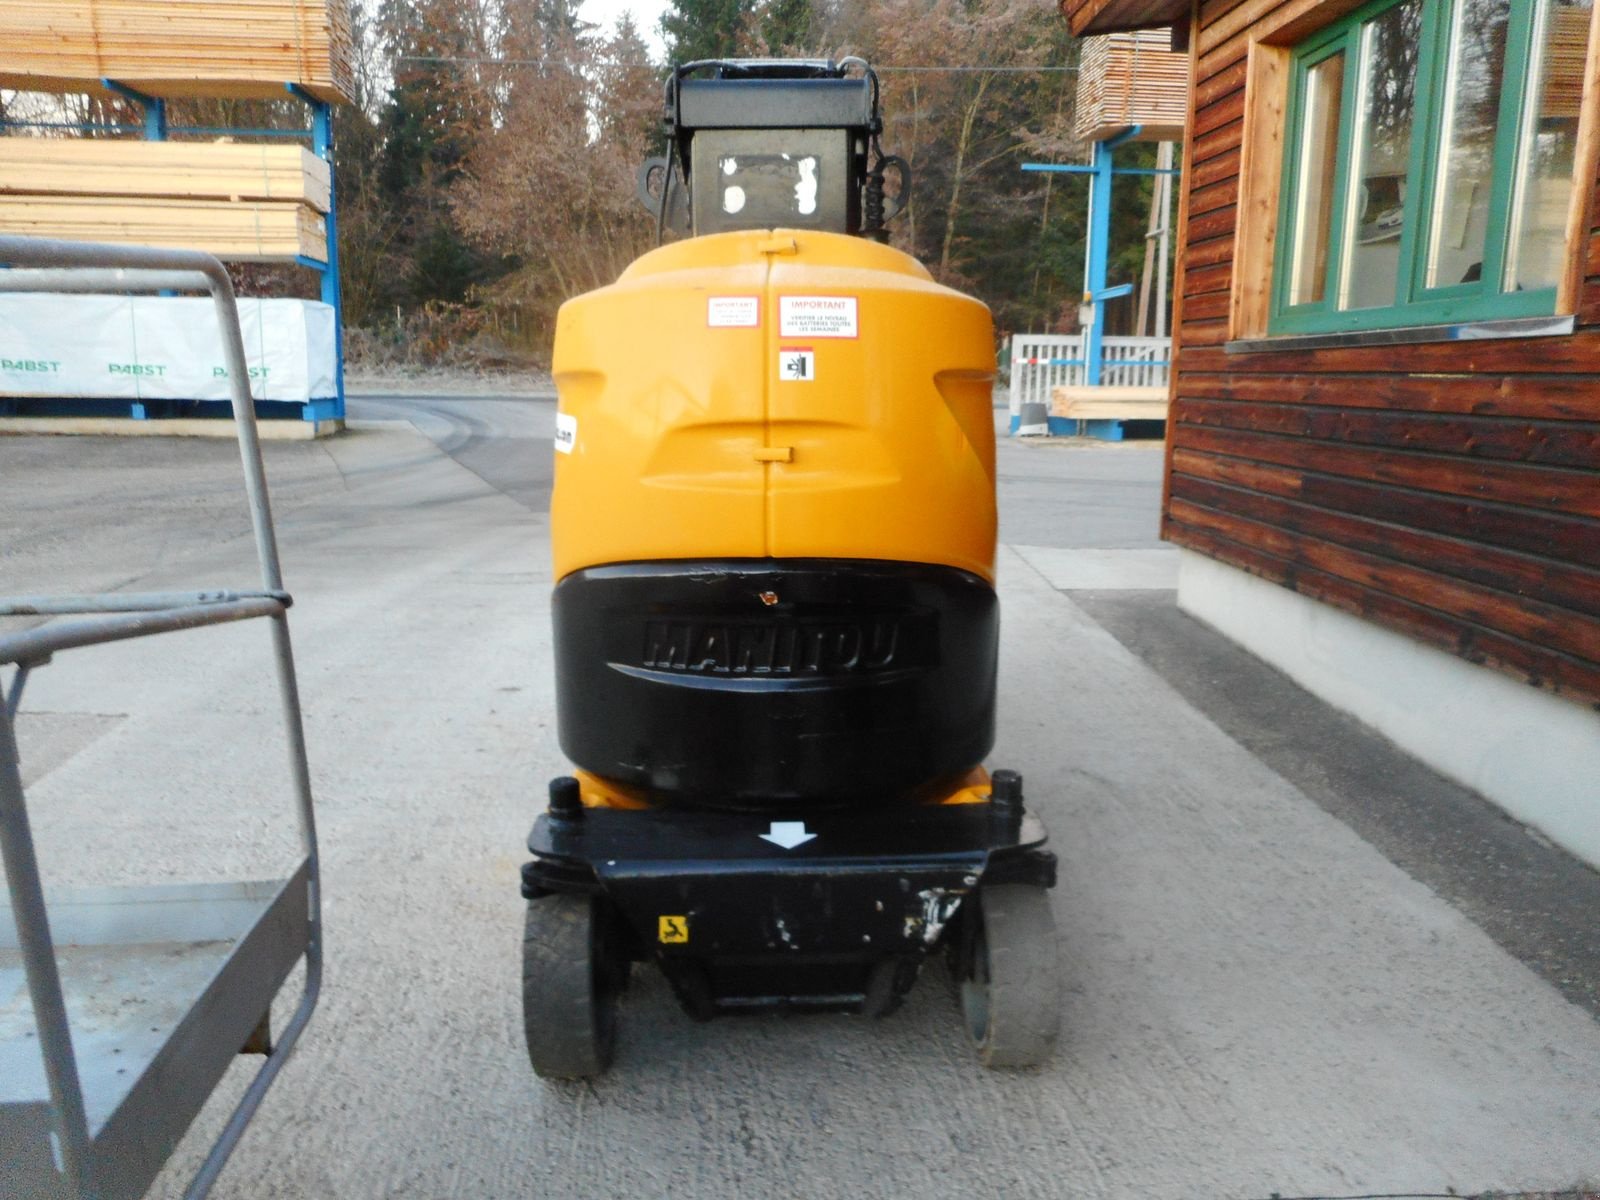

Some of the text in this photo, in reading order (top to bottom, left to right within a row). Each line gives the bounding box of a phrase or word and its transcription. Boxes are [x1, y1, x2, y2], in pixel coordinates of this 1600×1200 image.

[792, 300, 846, 309] IMPORTANT
[1, 359, 61, 373] PABST
[108, 363, 168, 377] PABST
[213, 366, 272, 378] PST
[643, 620, 899, 673] MANITOU
